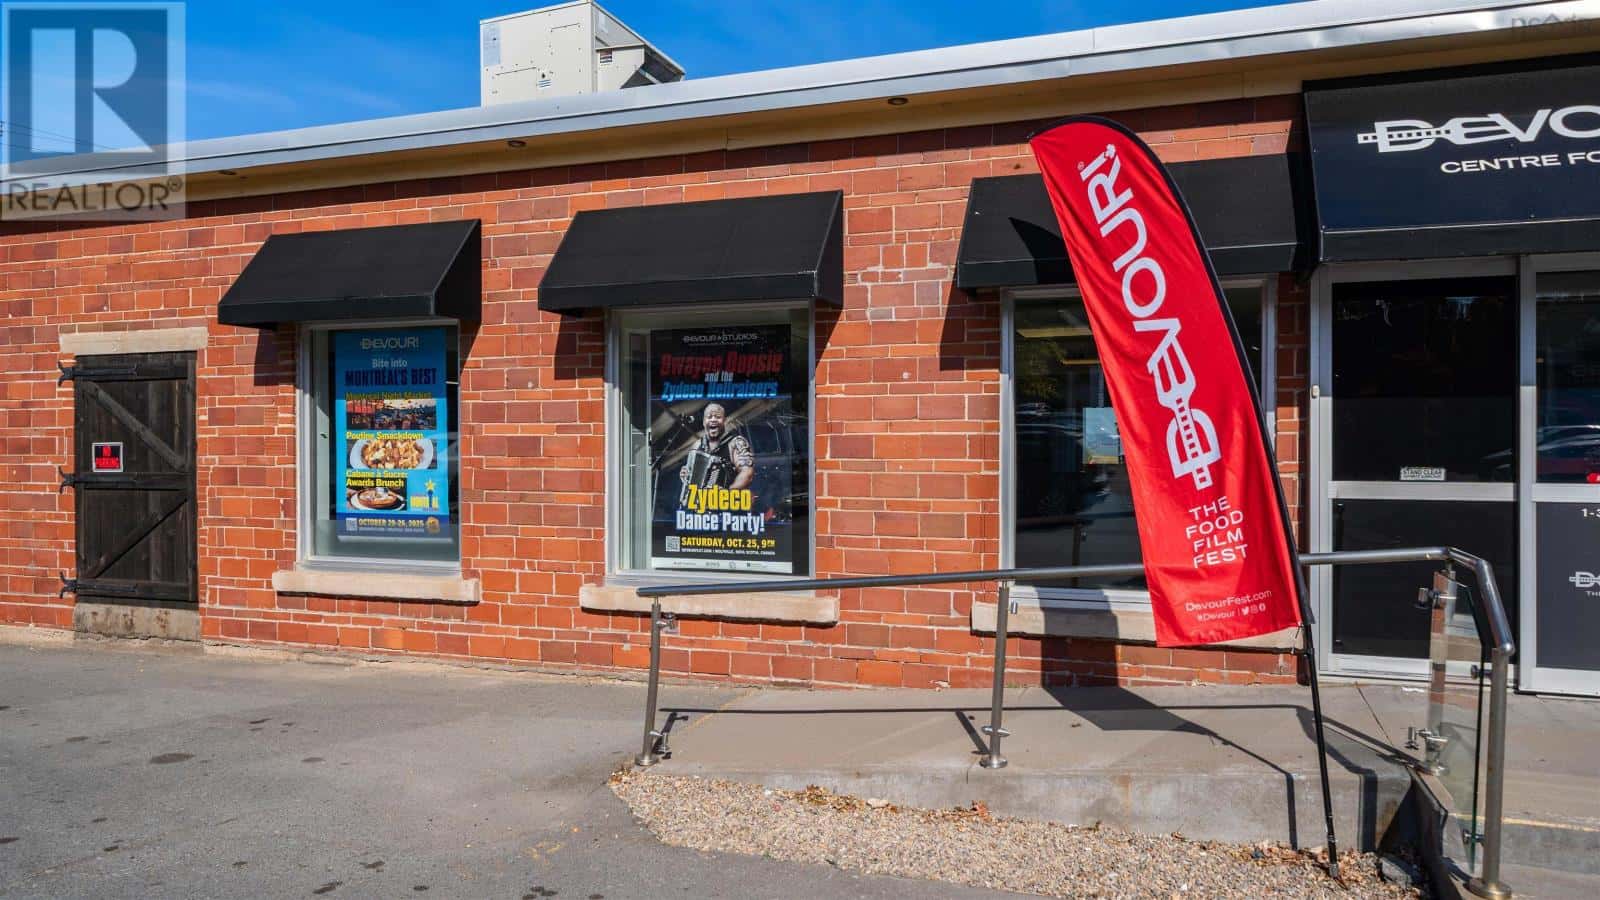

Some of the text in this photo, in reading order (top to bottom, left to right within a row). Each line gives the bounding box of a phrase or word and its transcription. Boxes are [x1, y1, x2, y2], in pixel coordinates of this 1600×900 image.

[1440, 154, 1561, 173] CENTRE
[360, 337, 420, 349] DEVOUR!
[372, 359, 408, 368] Bite into
[345, 368, 437, 386] MONTREAL'S BEST
[704, 370, 734, 382] and the
[662, 382, 704, 401] Zydeco
[346, 479, 404, 487] Awards Brunch
[687, 484, 751, 513] Zydeco
[1189, 496, 1231, 520] THE
[676, 510, 765, 535] Dance Party!
[1185, 510, 1244, 539] FOOD
[681, 536, 725, 548] SATURDAY,
[727, 539, 745, 548] OCT.
[747, 539, 760, 550] 25,
[1193, 528, 1244, 552] FILM
[1193, 544, 1248, 569] FEST
[1185, 590, 1272, 612] DevourFest.com
